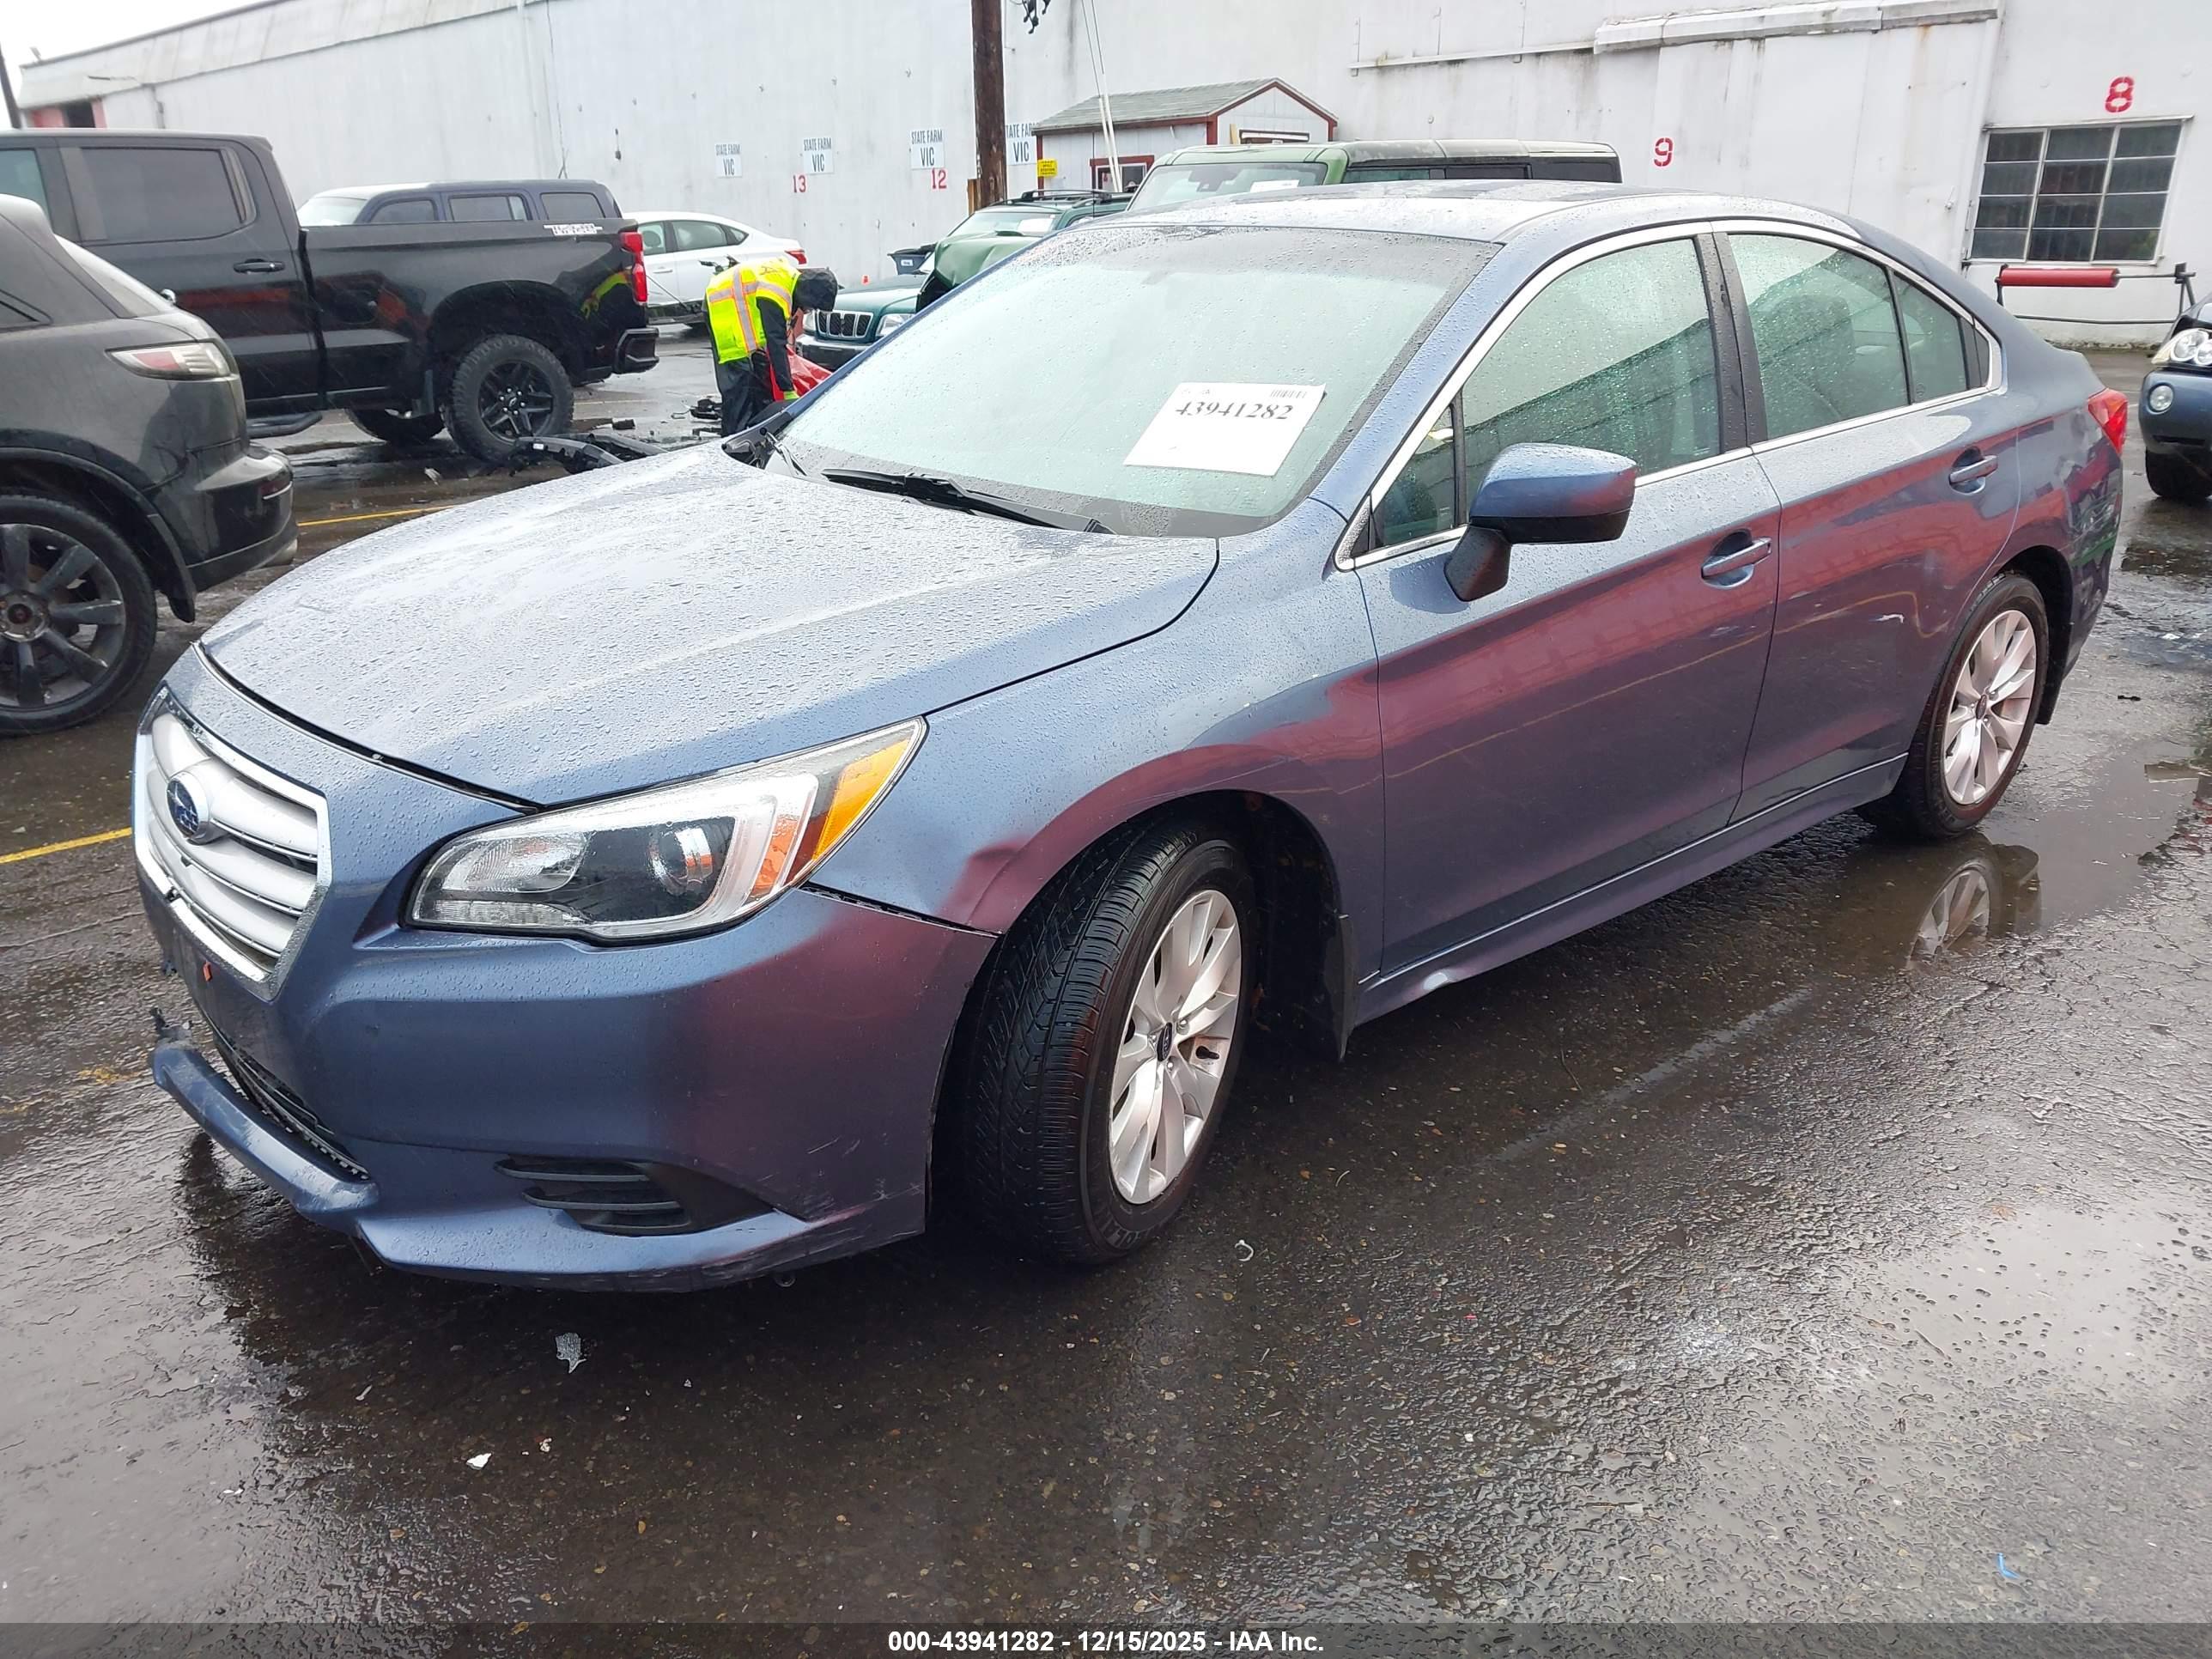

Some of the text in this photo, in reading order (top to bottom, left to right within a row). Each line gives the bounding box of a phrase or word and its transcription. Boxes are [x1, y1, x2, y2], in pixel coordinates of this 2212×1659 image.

[2105, 76, 2134, 112] 8
[911, 129, 943, 145] STATE FARM
[1006, 124, 1019, 138] TATE
[715, 143, 741, 156] STATE FARM
[804, 137, 832, 152] STATE FARM
[1013, 142, 1029, 162] VIC
[1653, 137, 1674, 167] 9
[811, 154, 825, 173] VIC
[921, 147, 935, 167] VIC
[723, 158, 735, 176] VIC
[793, 174, 807, 193] 13
[932, 167, 947, 189] 12
[1175, 400, 1294, 420] 43941282
